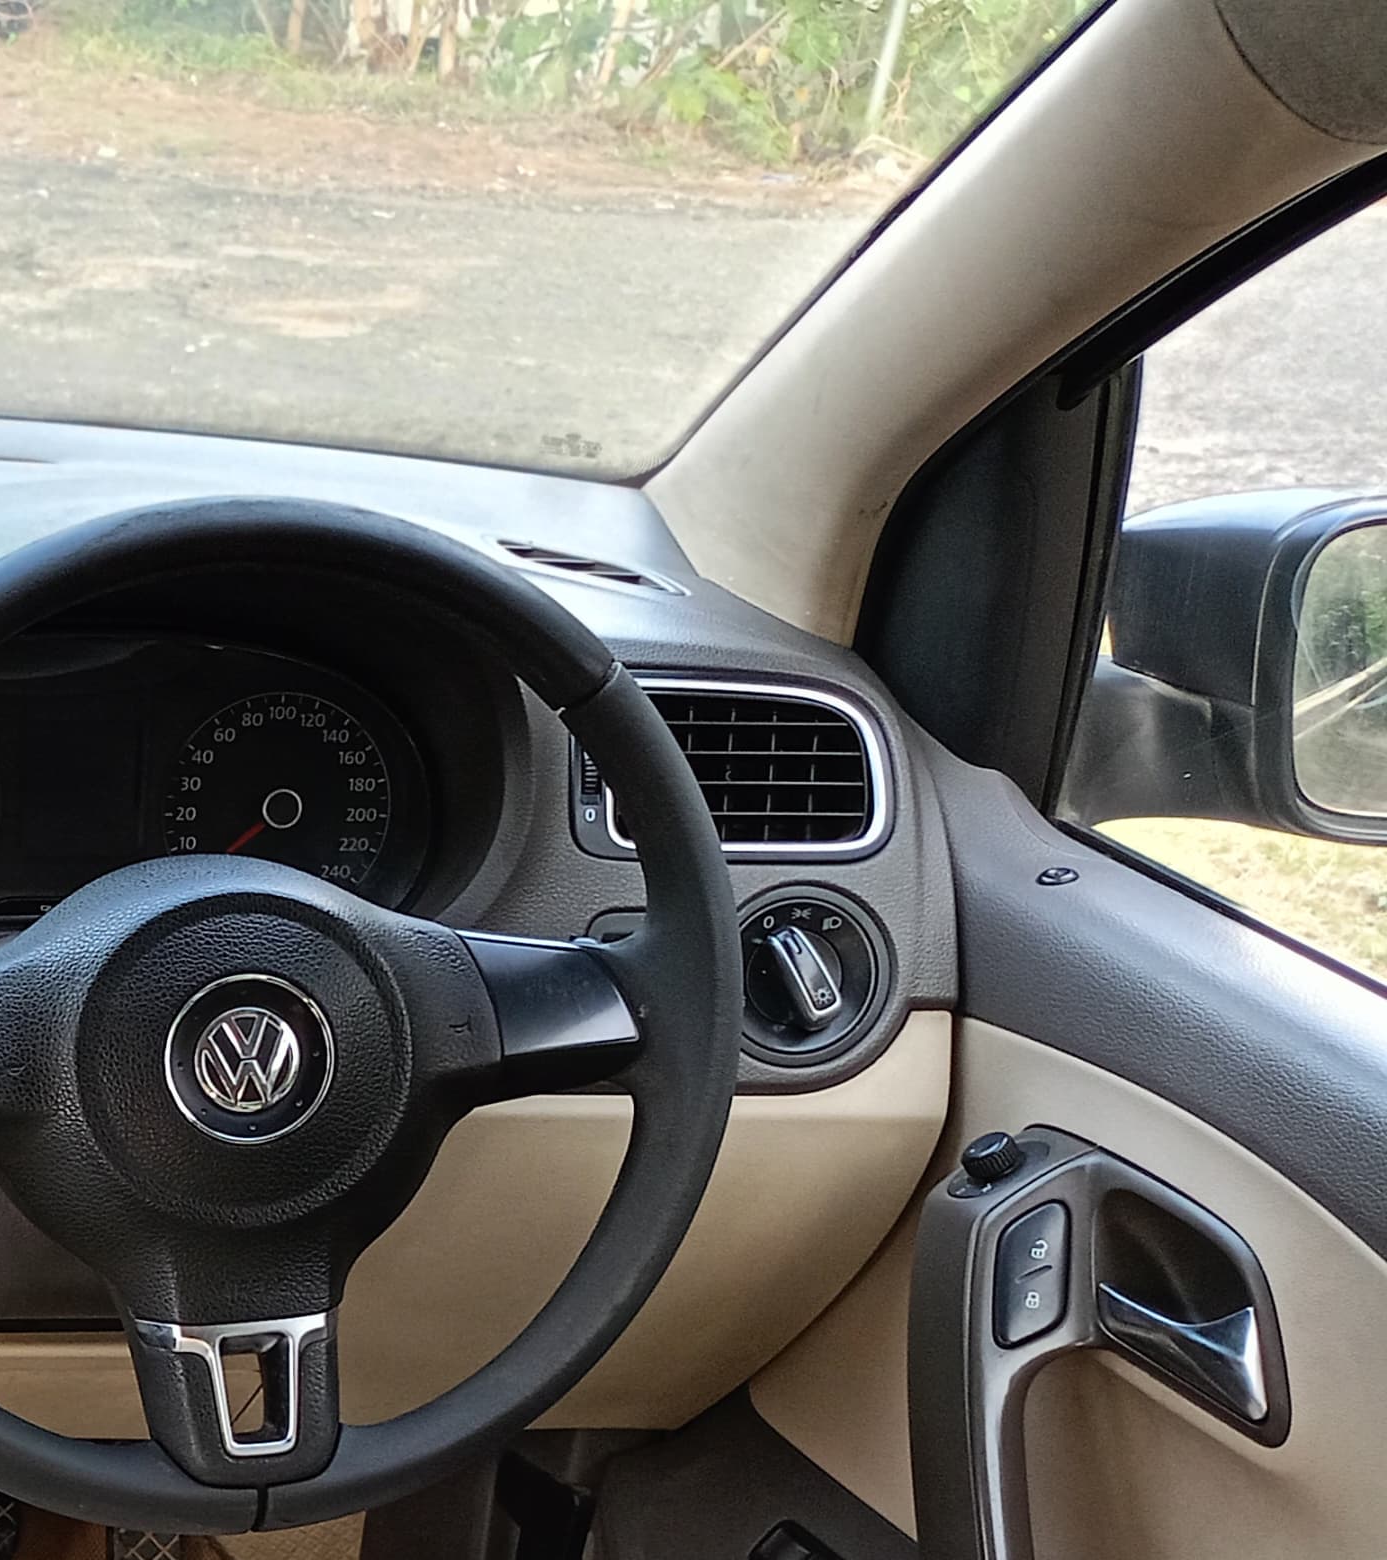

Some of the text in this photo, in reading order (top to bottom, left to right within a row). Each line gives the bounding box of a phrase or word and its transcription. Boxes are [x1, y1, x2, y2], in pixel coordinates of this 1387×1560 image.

[241, 712, 264, 727] 80
[269, 706, 297, 720] 100
[301, 713, 326, 727] 120
[214, 727, 236, 742] 60
[322, 729, 349, 743] 140
[191, 749, 214, 764] 40
[339, 751, 366, 765] 160
[180, 777, 202, 791] 30
[348, 777, 376, 791] 180
[175, 807, 197, 822] 20
[345, 807, 377, 822] 200
[179, 836, 197, 850] 10
[339, 837, 369, 851] 220
[320, 865, 351, 880] 240
